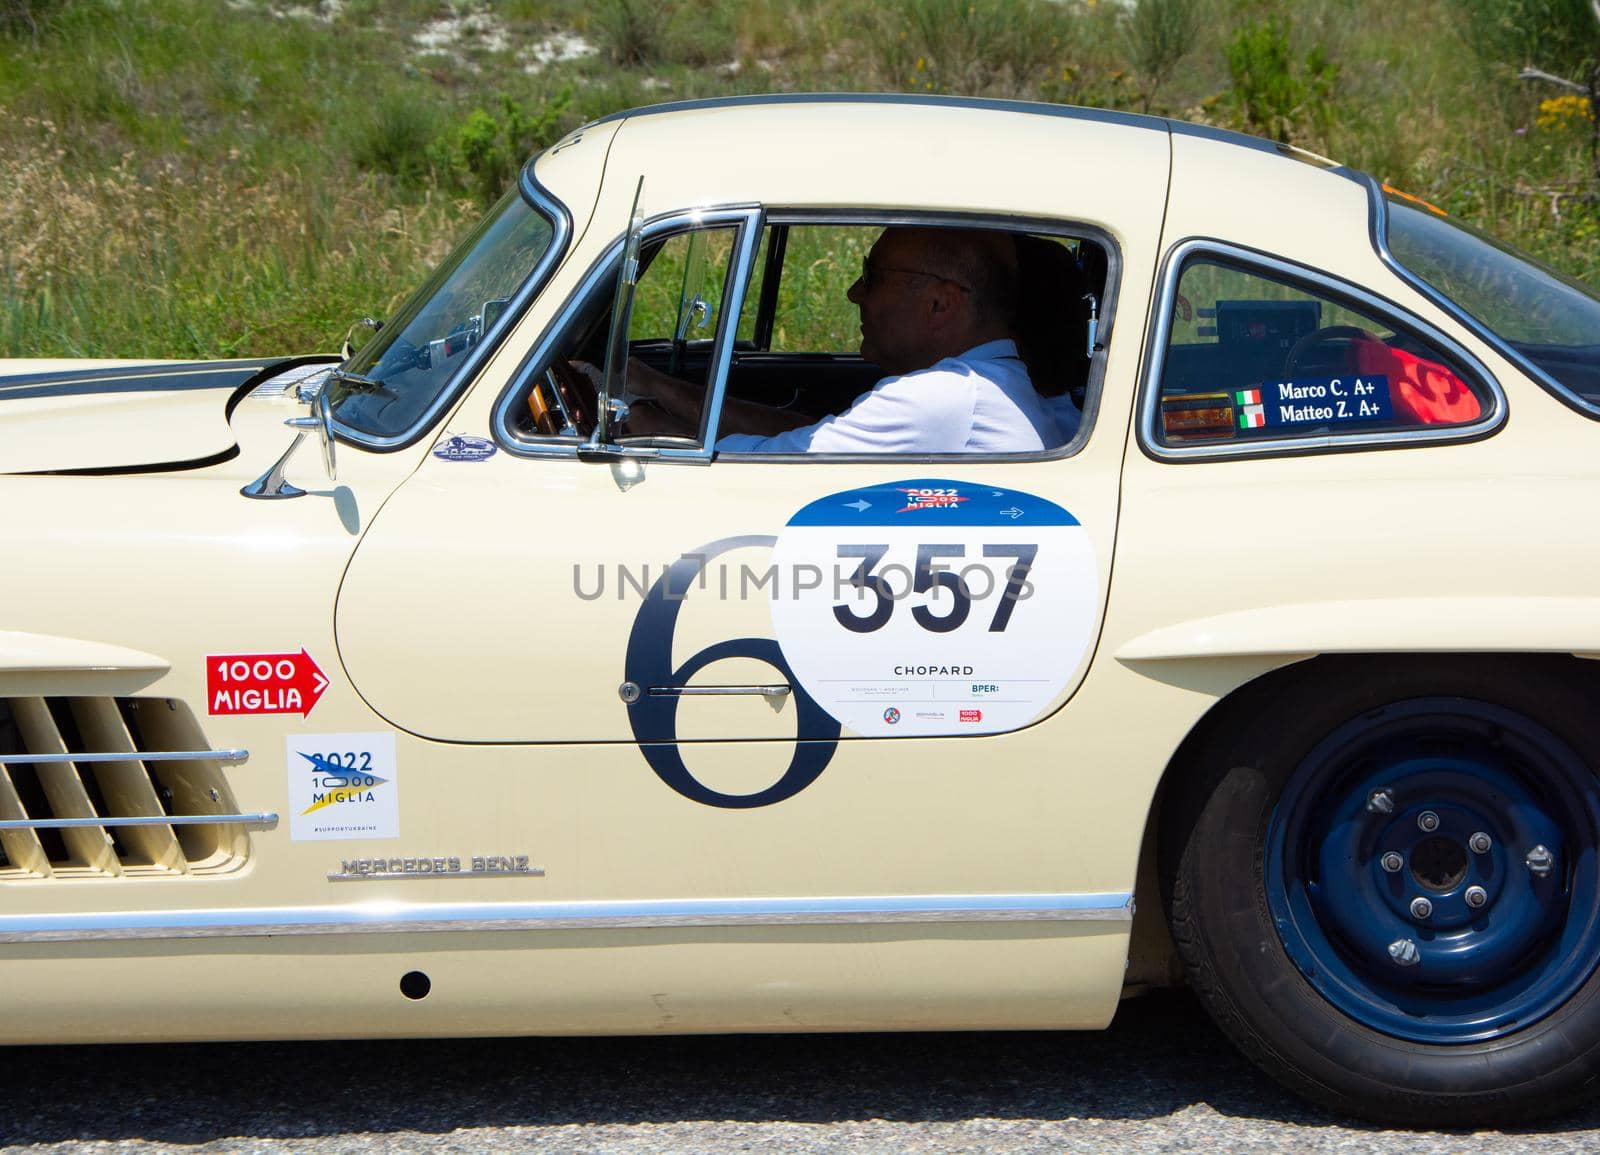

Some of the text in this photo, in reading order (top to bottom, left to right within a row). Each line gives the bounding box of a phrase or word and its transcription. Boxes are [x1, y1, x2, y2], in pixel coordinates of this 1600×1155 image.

[1278, 378, 1375, 400] Marco C. A+
[1280, 399, 1380, 422] Matteo Z. A+
[907, 488, 958, 497] 2022
[832, 543, 1039, 634] 357
[217, 659, 296, 682] 1000
[624, 534, 842, 810] 6
[894, 665, 974, 676] CHOPARD
[213, 687, 302, 712] MIGLIA
[312, 751, 373, 773] 2022
[312, 776, 375, 788] 1000
[313, 791, 375, 804] MIGLIA
[341, 855, 529, 875] MERCEDES BENZ
